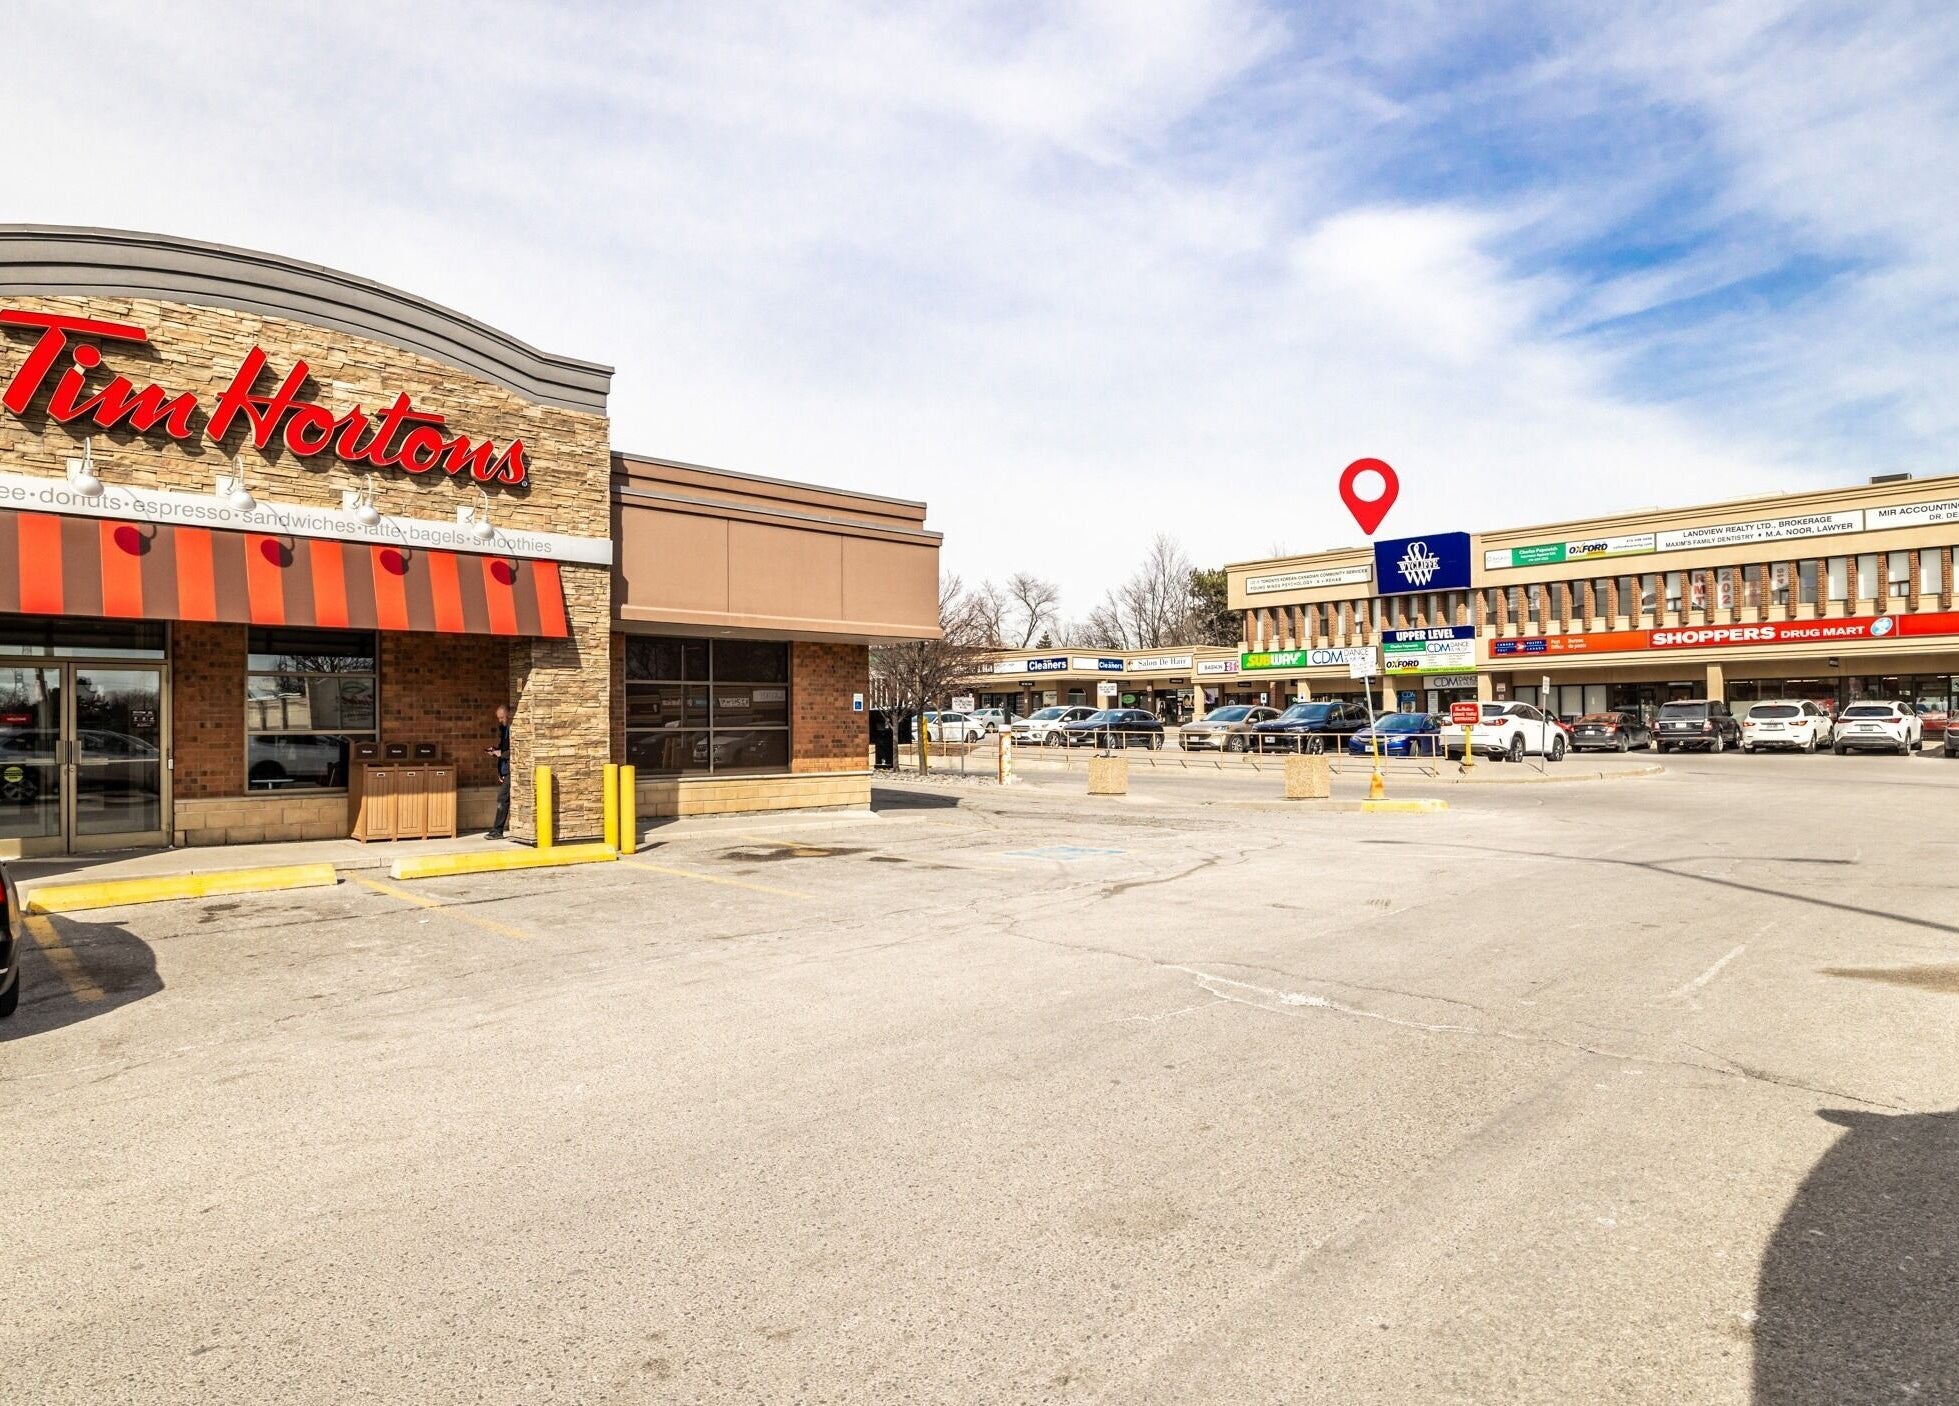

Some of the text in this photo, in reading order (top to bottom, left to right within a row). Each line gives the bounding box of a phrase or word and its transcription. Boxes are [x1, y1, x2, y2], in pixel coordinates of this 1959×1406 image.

[0, 309, 526, 484] Tim Hortons
[1878, 502, 1959, 518] MIR ACCOUNTIN
[39, 486, 121, 512] donuts
[132, 497, 231, 521] espresso
[242, 508, 356, 535] sandwiches
[409, 526, 465, 548] bagels
[472, 534, 552, 553] smoothies
[1683, 527, 1724, 538] LANDVIEW
[1725, 524, 1754, 533] REALTY
[1779, 516, 1832, 527] BROKERAGE
[1665, 523, 1853, 548] MAXIM'S FAMILY DENTISTRY M.A. NOOR, LAWYER
[1569, 542, 1608, 554] OXFORD
[1722, 571, 1731, 604] 202
[1396, 628, 1455, 641] UPPER LEVEL
[1652, 626, 1866, 646] SHOPPERS DRUG MART
[1344, 648, 1369, 656] DANCE
[1427, 642, 1451, 653] CDM
[1138, 656, 1187, 668] Salon De Hair
[1246, 651, 1302, 667] SUBWAY
[1312, 650, 1343, 664] CDM
[1386, 658, 1419, 669] OXFORD
[1028, 660, 1067, 671] Cleaners
[1099, 662, 1123, 670] Cleaners
[1434, 676, 1458, 687] CDM
